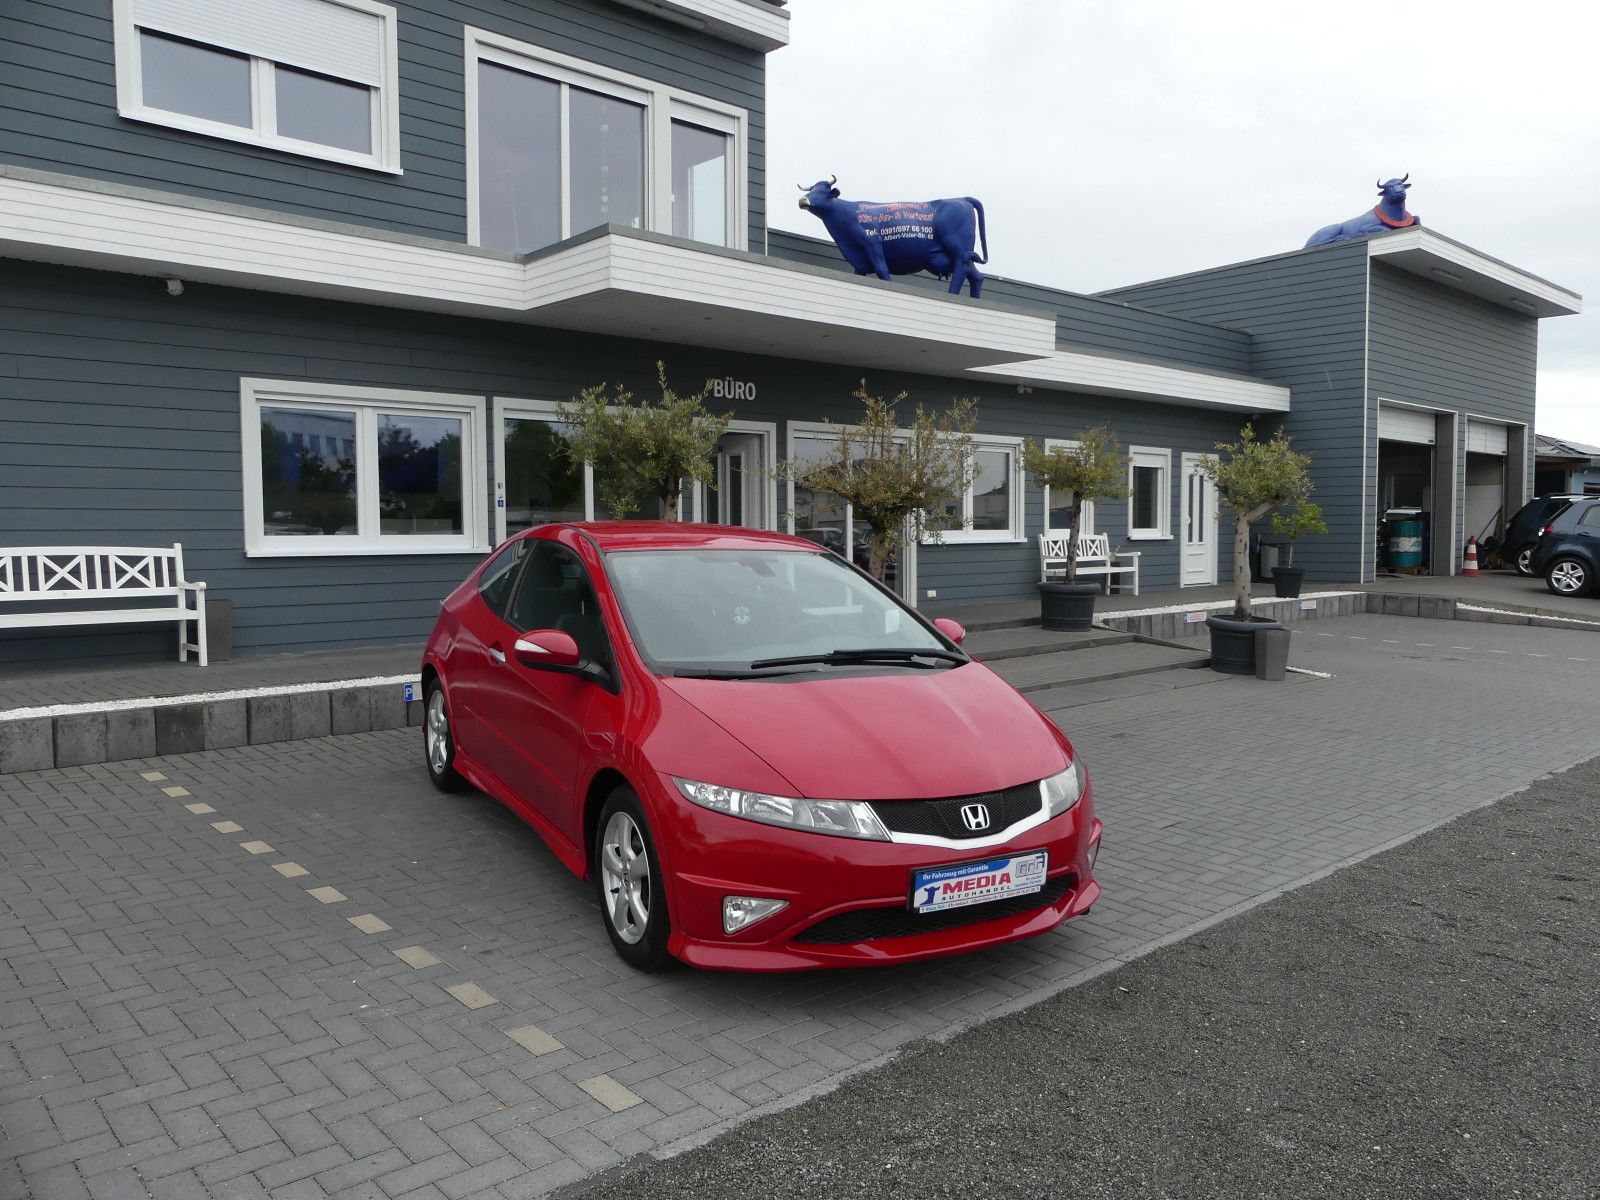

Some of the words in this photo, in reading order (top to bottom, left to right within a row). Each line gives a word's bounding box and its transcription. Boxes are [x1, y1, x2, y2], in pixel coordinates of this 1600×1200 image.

[865, 228, 878, 236] Tel.
[921, 226, 933, 234] 100
[713, 376, 757, 401] BÜRO
[942, 872, 1012, 894] MEDIA
[941, 885, 1011, 901] AUTOHANDEL
